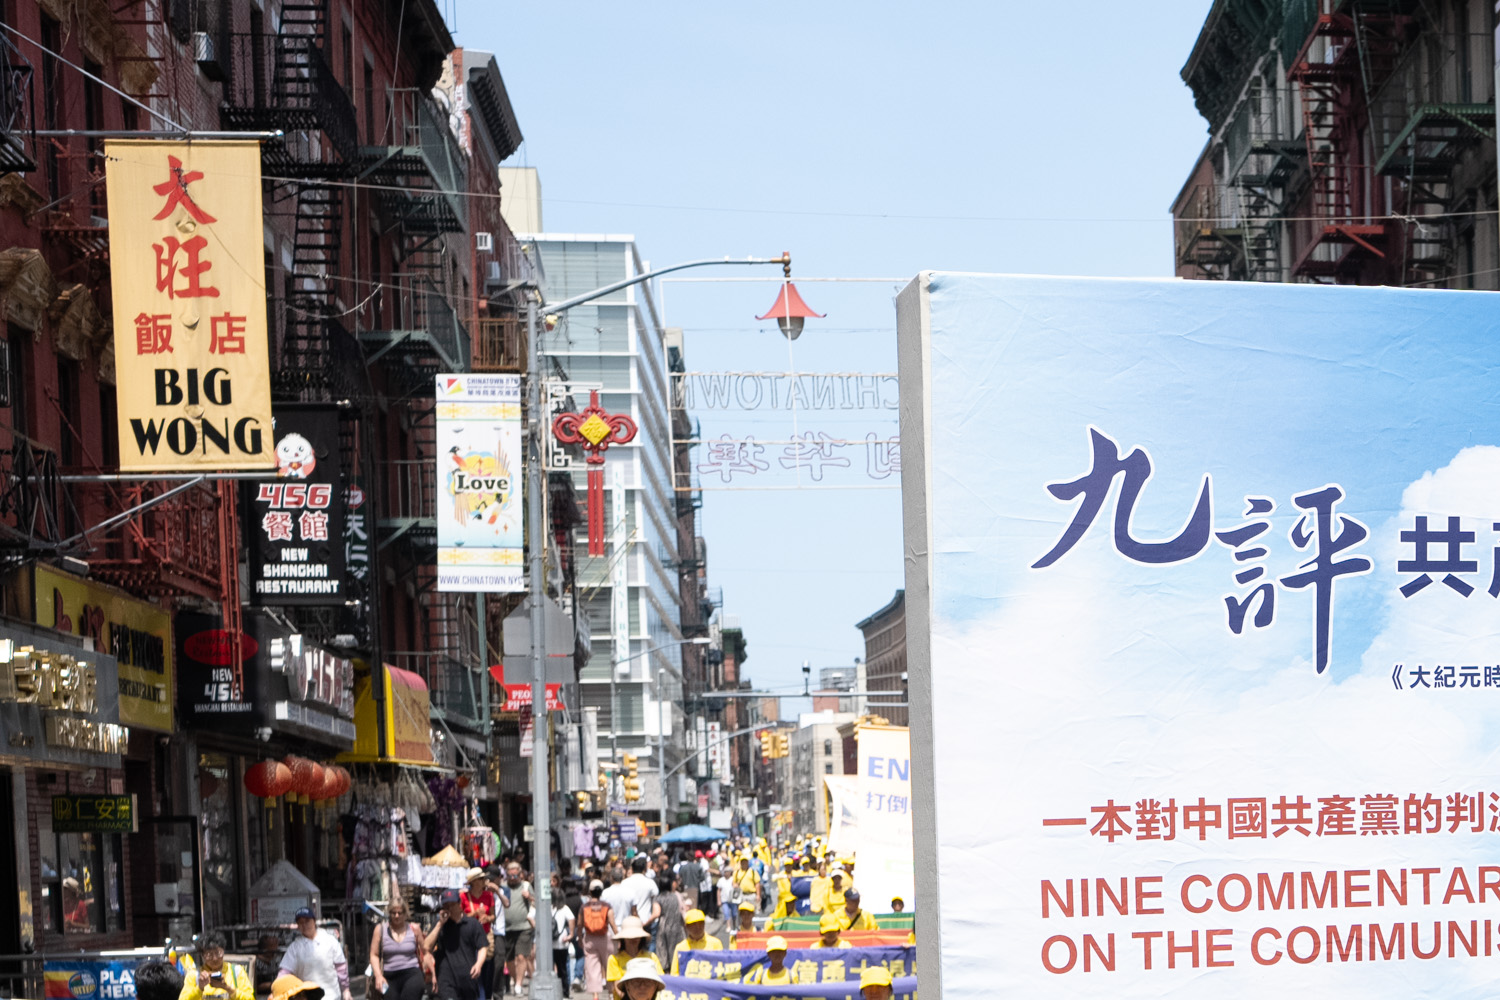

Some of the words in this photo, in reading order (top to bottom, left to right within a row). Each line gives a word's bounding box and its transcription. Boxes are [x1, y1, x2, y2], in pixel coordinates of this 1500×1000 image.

[152, 154, 220, 300] 大旺
[134, 312, 247, 355] 飯店
[154, 367, 232, 406] BIG
[130, 417, 262, 456] WONG
[255, 484, 331, 508] 456
[457, 475, 508, 489] Love
[262, 511, 329, 541] 餐館
[281, 548, 308, 561] NEW
[263, 564, 328, 577] SHANGHAI
[440, 575, 524, 585] WWW.CHINATOWN.NYC
[256, 580, 339, 593] RESTAURANT
[1041, 875, 1163, 919] NINE
[1041, 932, 1115, 975] ON
[1131, 928, 1234, 970] THE
